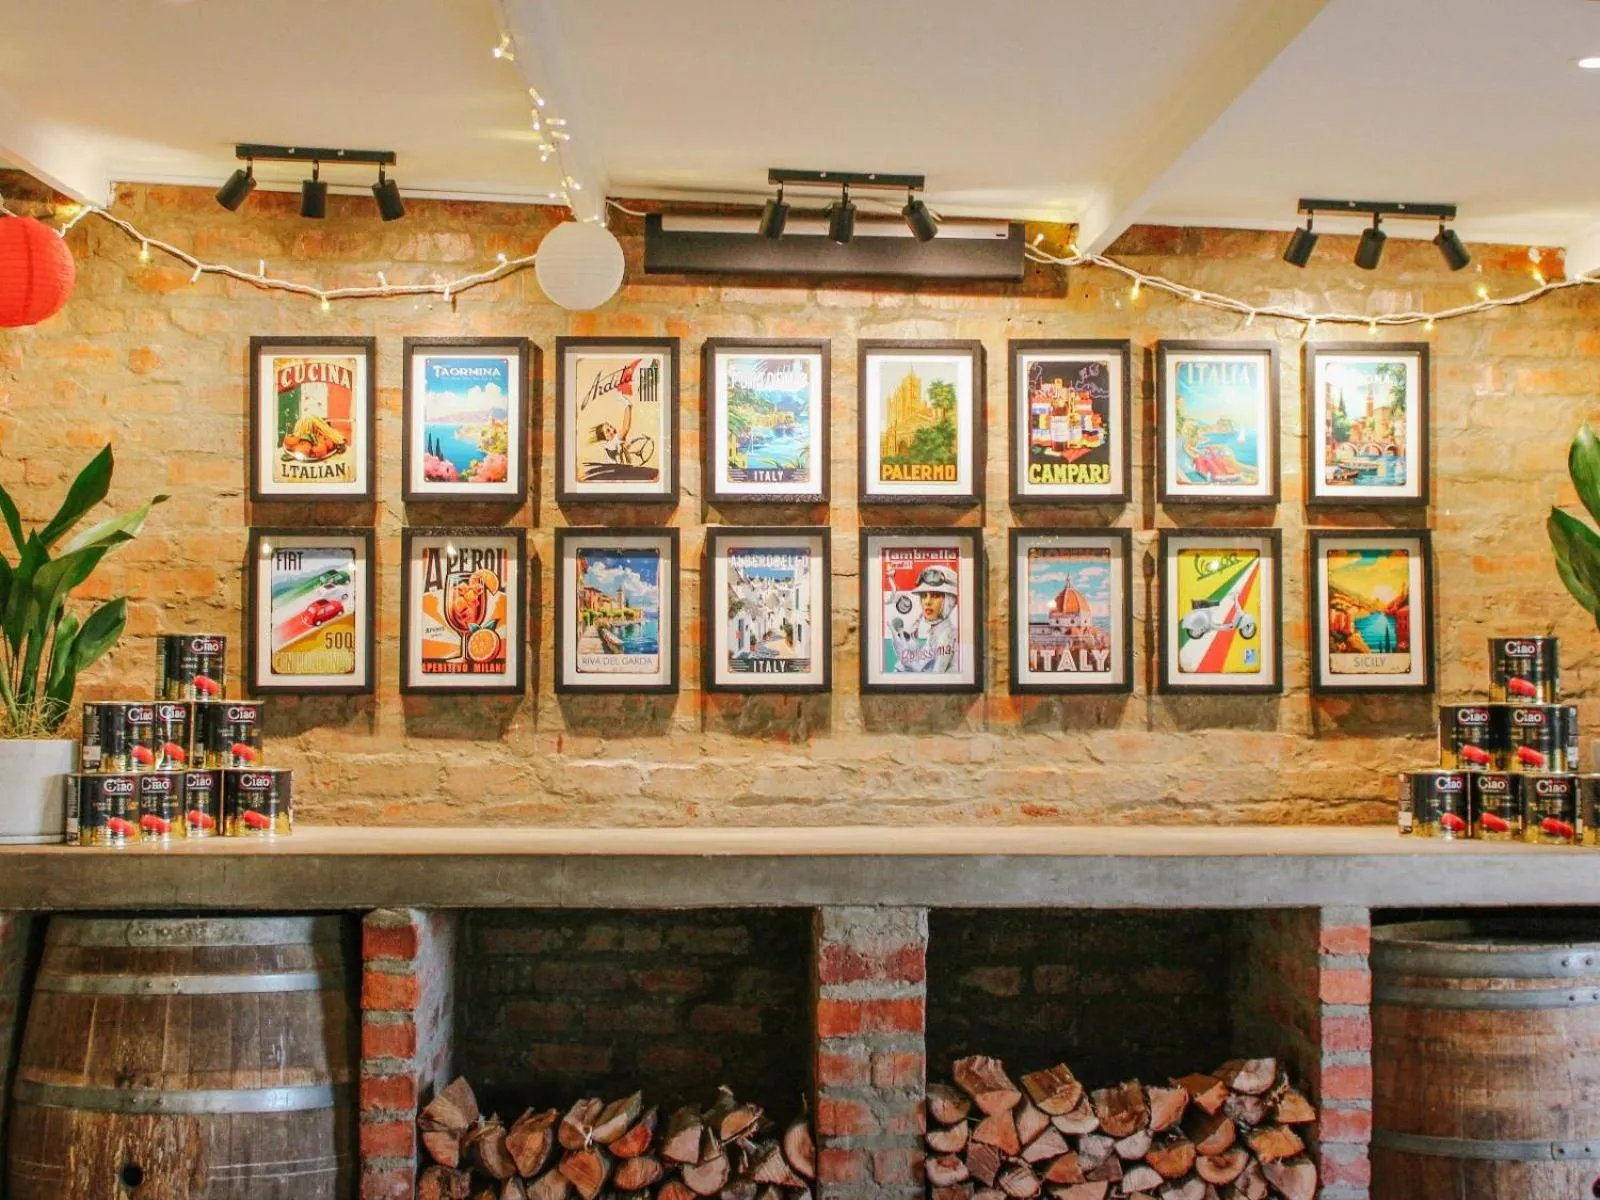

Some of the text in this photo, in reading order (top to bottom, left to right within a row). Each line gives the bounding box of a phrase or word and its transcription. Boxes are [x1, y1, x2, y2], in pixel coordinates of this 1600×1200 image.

[280, 363, 350, 388] CUCINA
[432, 365, 502, 378] TAORMINA
[1187, 362, 1250, 386] ITALIA
[581, 365, 632, 411] Ardita
[639, 367, 658, 402] FIAT
[754, 469, 784, 482] ITALY
[882, 465, 956, 481] PALERMO
[1029, 464, 1110, 483] CAMPARI
[276, 551, 303, 572] FIAT
[324, 632, 353, 650] 500
[1505, 641, 1535, 656] Ciao
[582, 656, 652, 667] RIVA DEL GARDA
[753, 660, 786, 673] ITALY
[1032, 649, 1107, 671] ITALY
[1353, 656, 1387, 668] SICILY
[128, 706, 153, 722] Ciao
[159, 705, 185, 720] Ciao
[228, 706, 255, 721] Ciao
[1458, 709, 1488, 722] Ciao
[1514, 709, 1542, 723] Ciao
[241, 774, 270, 788] Ciao
[1436, 776, 1463, 791] Ciao
[1478, 777, 1506, 790] Ciao
[1536, 779, 1568, 794] Ciao
